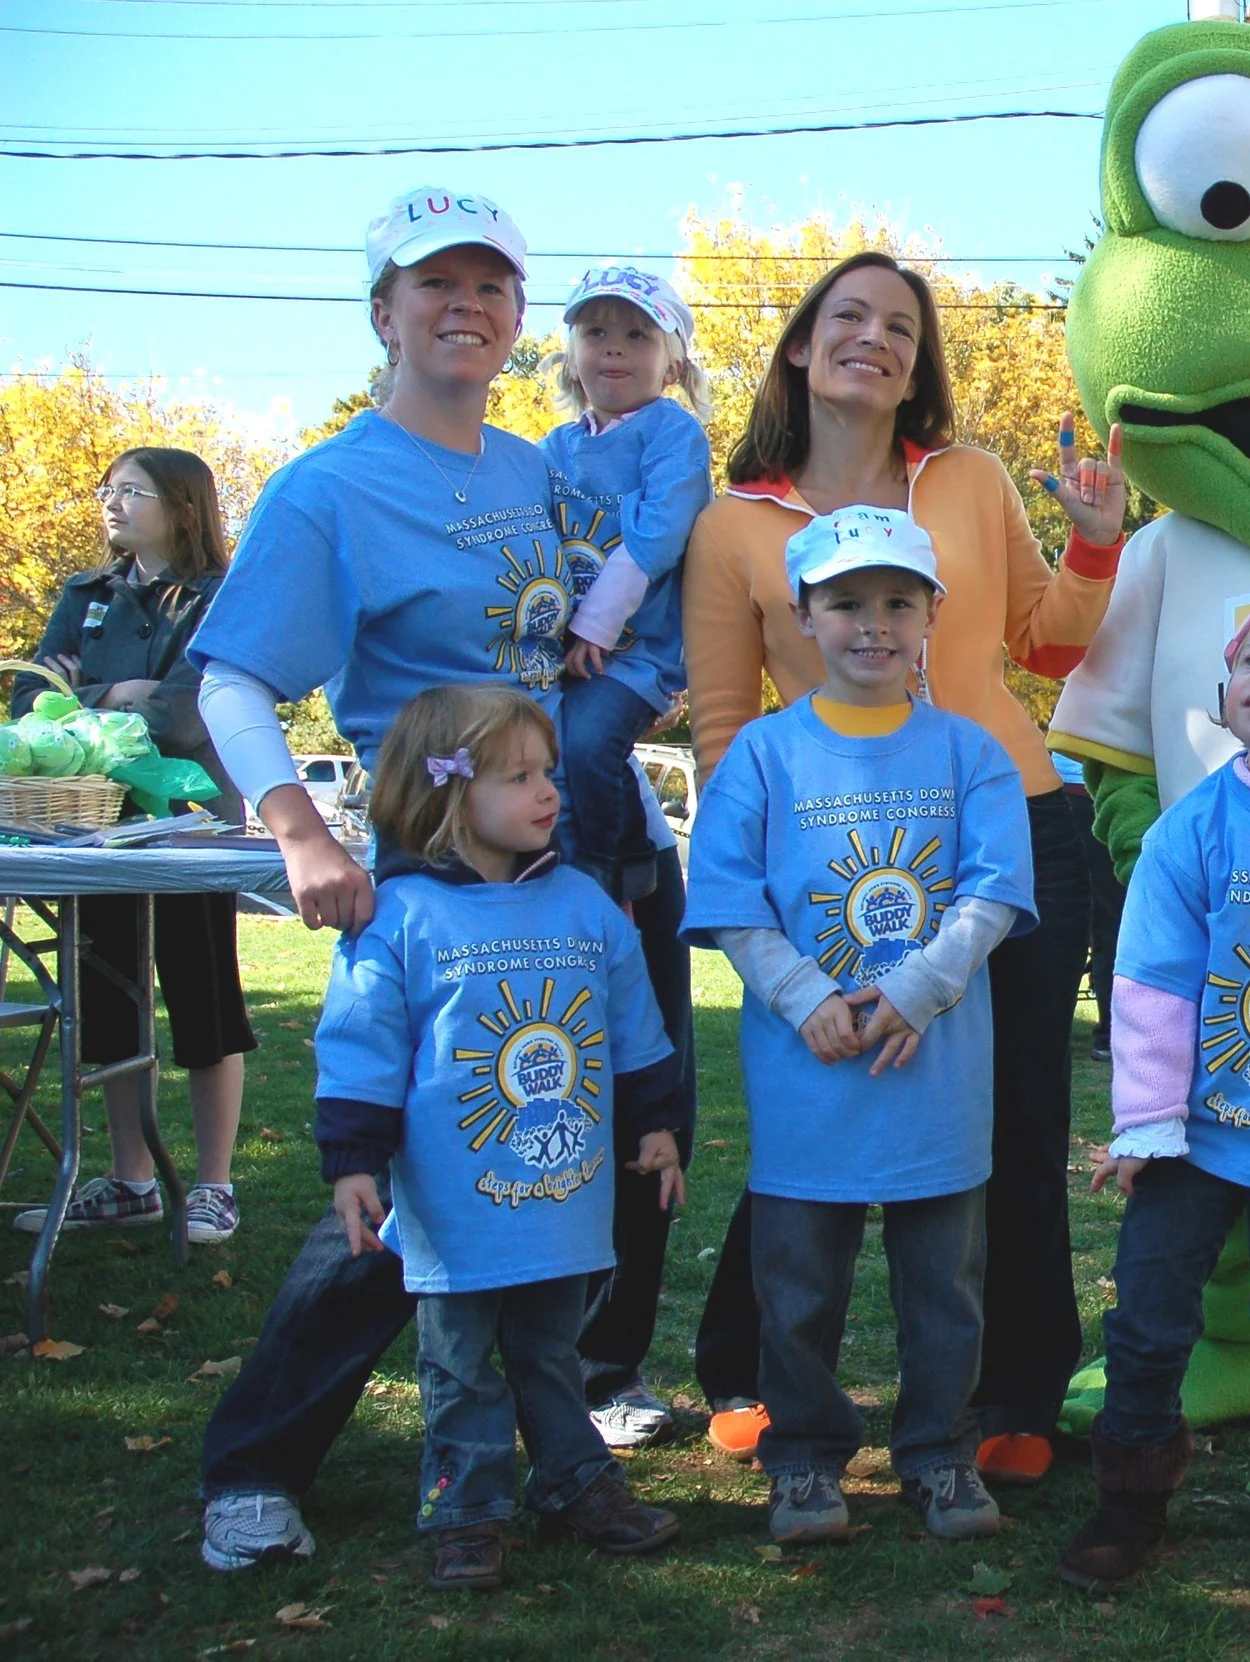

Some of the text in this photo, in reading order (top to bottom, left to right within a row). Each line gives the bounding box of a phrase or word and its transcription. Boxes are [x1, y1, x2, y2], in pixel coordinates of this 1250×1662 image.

[408, 196, 499, 222] LUCY
[582, 269, 660, 297] LUCY
[456, 518, 554, 549] SYNDROME CONGRE
[794, 789, 914, 814] MASSACHUSETTS
[800, 805, 956, 831] SYNDROME CONGRESS
[863, 904, 913, 927] BUDDY
[868, 918, 910, 938] WALK
[437, 937, 561, 964] MASSACHUSETTS
[444, 957, 531, 981] SYNDROME
[516, 1062, 565, 1086] BUDDY
[522, 1077, 563, 1098] WALK
[477, 1170, 512, 1204] steps
[510, 1180, 531, 1208] for
[532, 1182, 545, 1198] a
